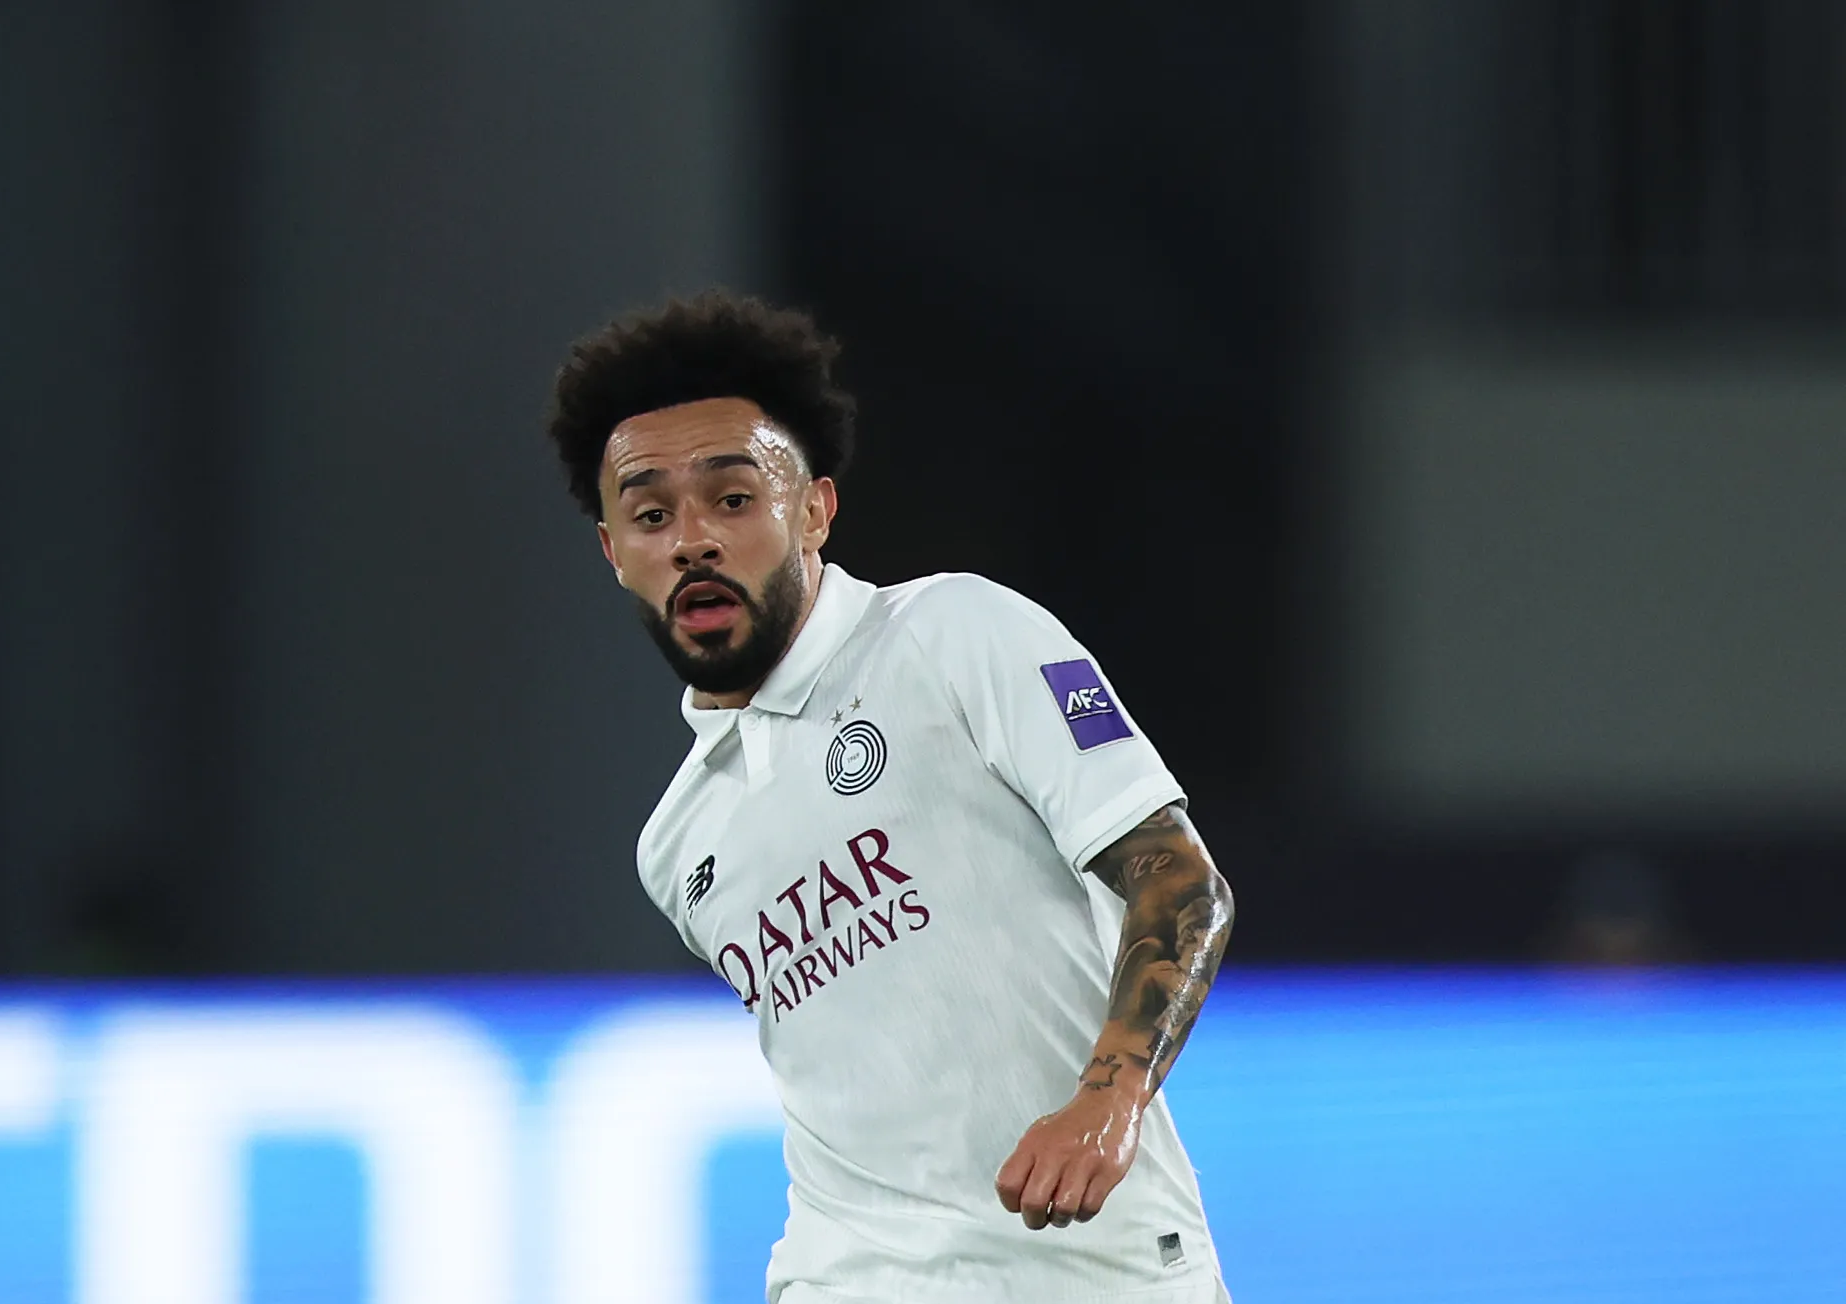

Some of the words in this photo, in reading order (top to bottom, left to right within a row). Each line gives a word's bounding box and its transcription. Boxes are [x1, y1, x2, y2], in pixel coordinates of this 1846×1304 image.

[1065, 686, 1108, 714] AFC
[718, 828, 913, 1007] QATAR
[771, 889, 930, 1023] AIRWAYS
